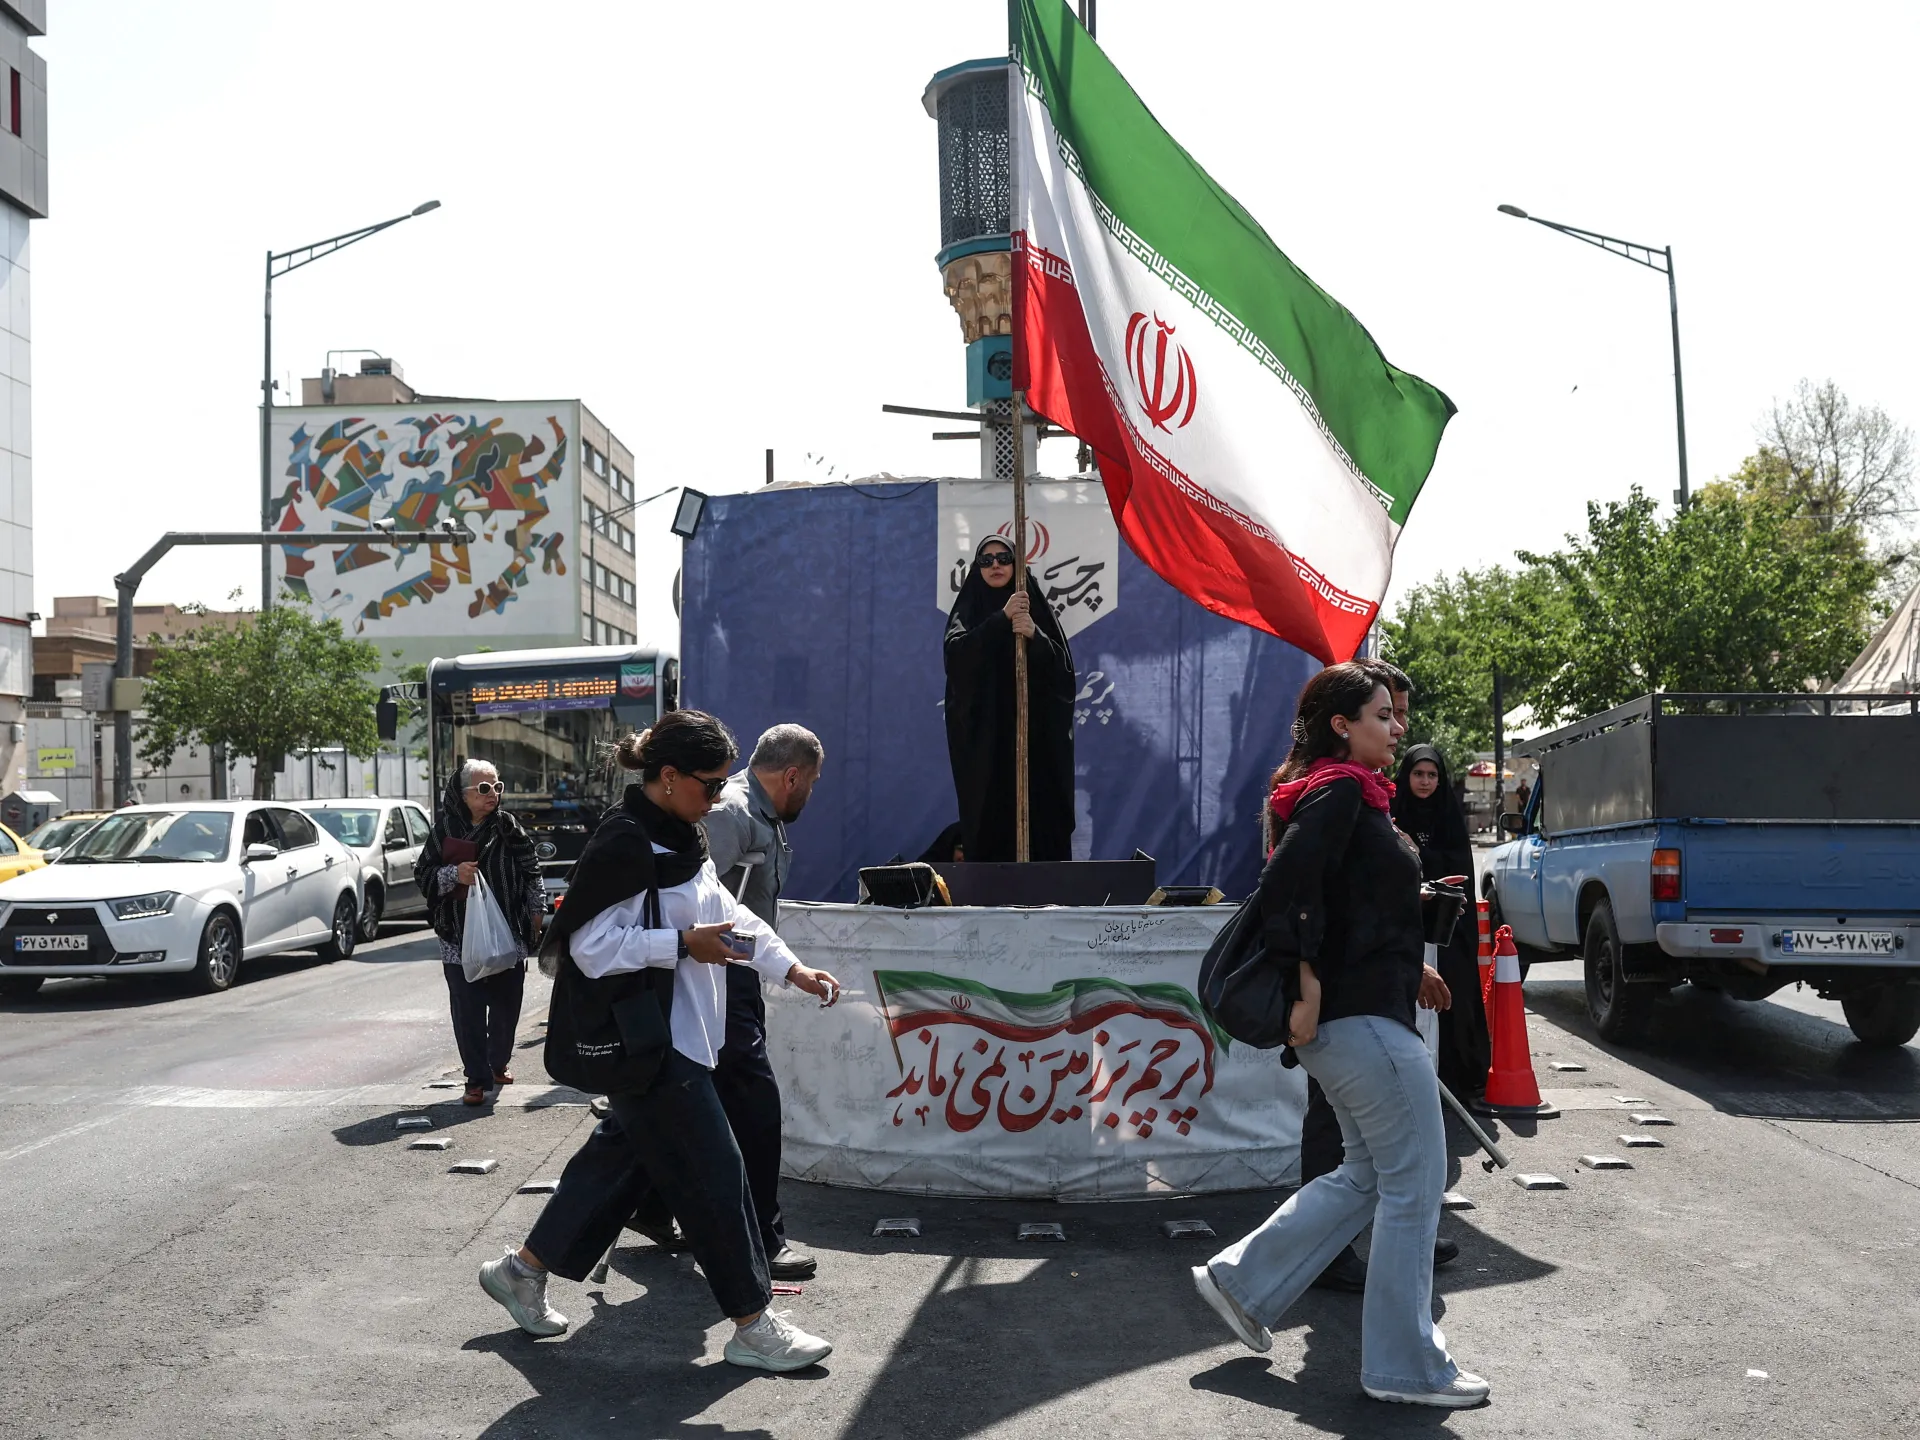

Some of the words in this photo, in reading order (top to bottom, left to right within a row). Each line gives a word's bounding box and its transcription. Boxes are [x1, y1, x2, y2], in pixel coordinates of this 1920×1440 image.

[1087, 933, 1110, 950] ایران
[1104, 920, 1120, 933] جان
[996, 1029, 1110, 1133] زمین
[1120, 1038, 1200, 1140] پرچم
